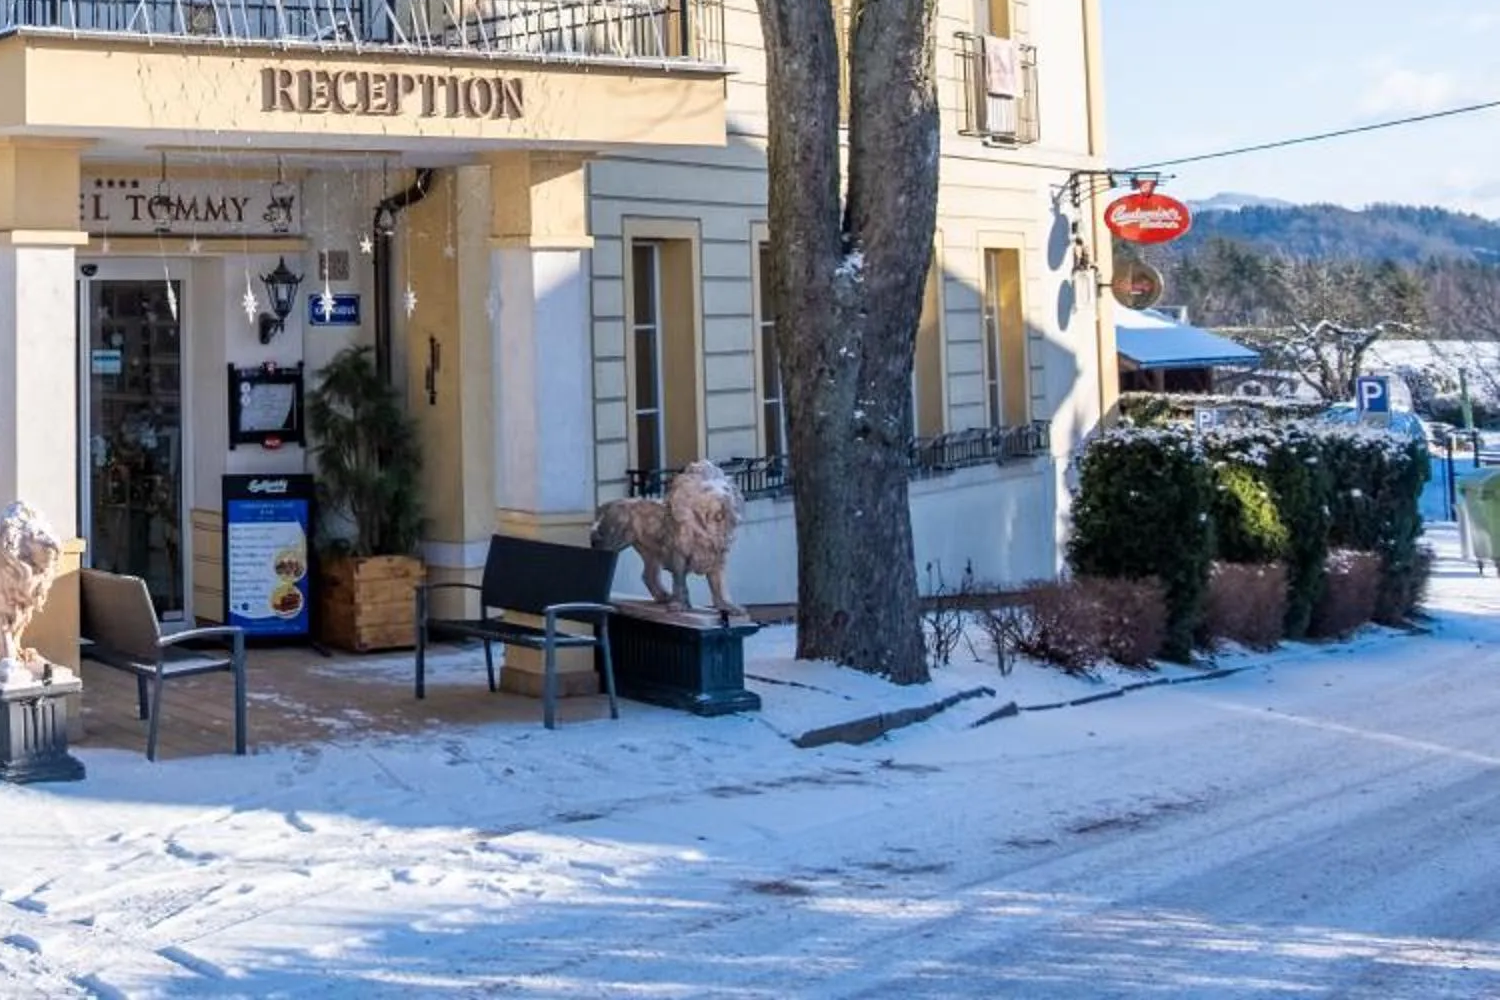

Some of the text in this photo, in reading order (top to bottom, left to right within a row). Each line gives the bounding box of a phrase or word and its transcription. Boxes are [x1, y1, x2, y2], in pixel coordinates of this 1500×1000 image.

[260, 66, 525, 120] RECEPTION
[126, 194, 250, 222] TOMMY
[1362, 381, 1383, 410] P
